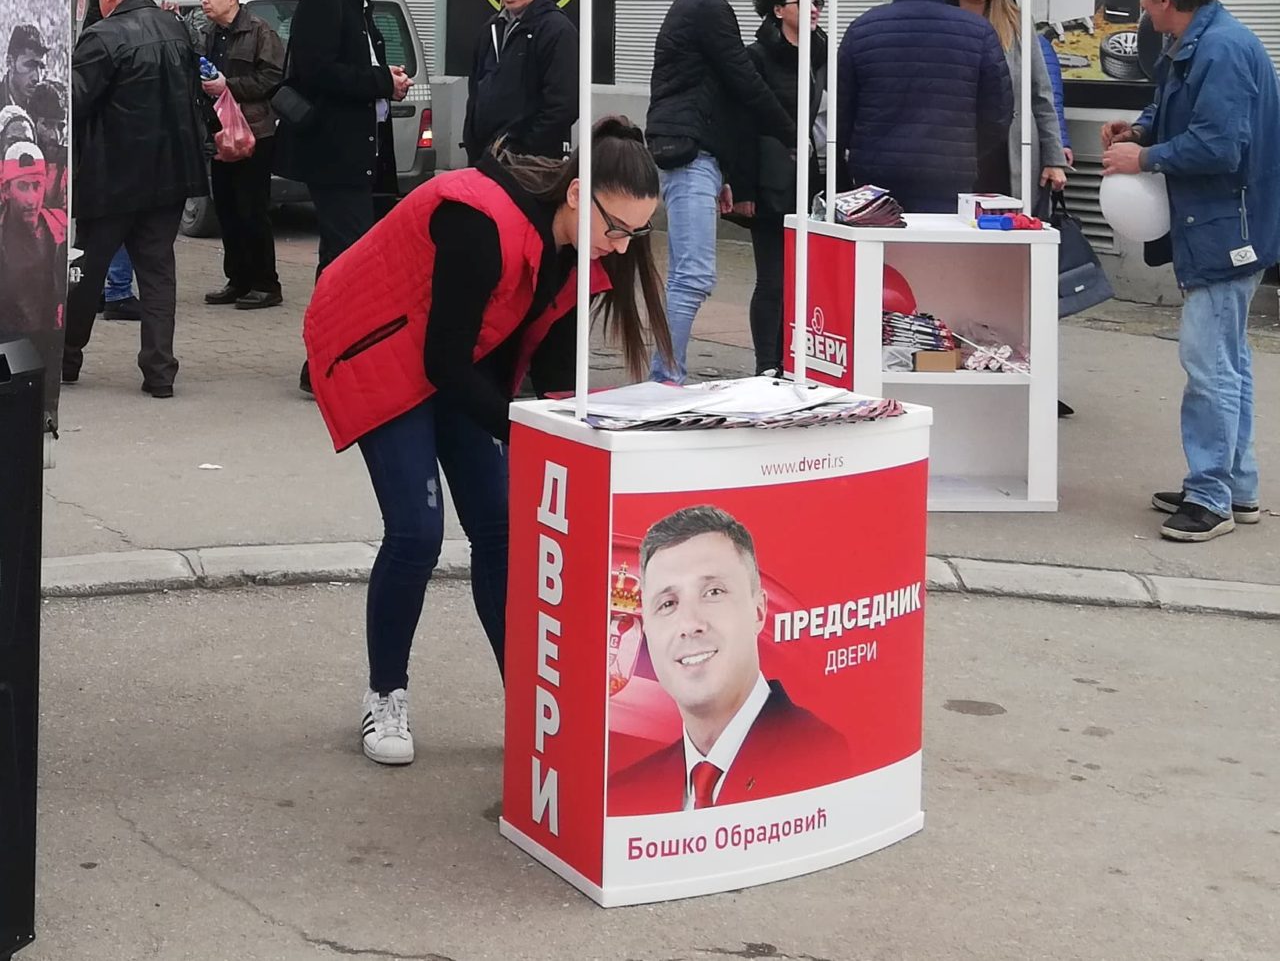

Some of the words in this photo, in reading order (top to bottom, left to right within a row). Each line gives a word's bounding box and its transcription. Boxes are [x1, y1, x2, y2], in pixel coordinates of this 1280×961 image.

[761, 453, 844, 476] www.dveri.rs
[773, 581, 922, 643] ПРЕДСЕДНИК
[824, 640, 878, 675] ДВЕРИ
[627, 832, 708, 861] Бошко
[715, 807, 828, 856] Обрадовић
